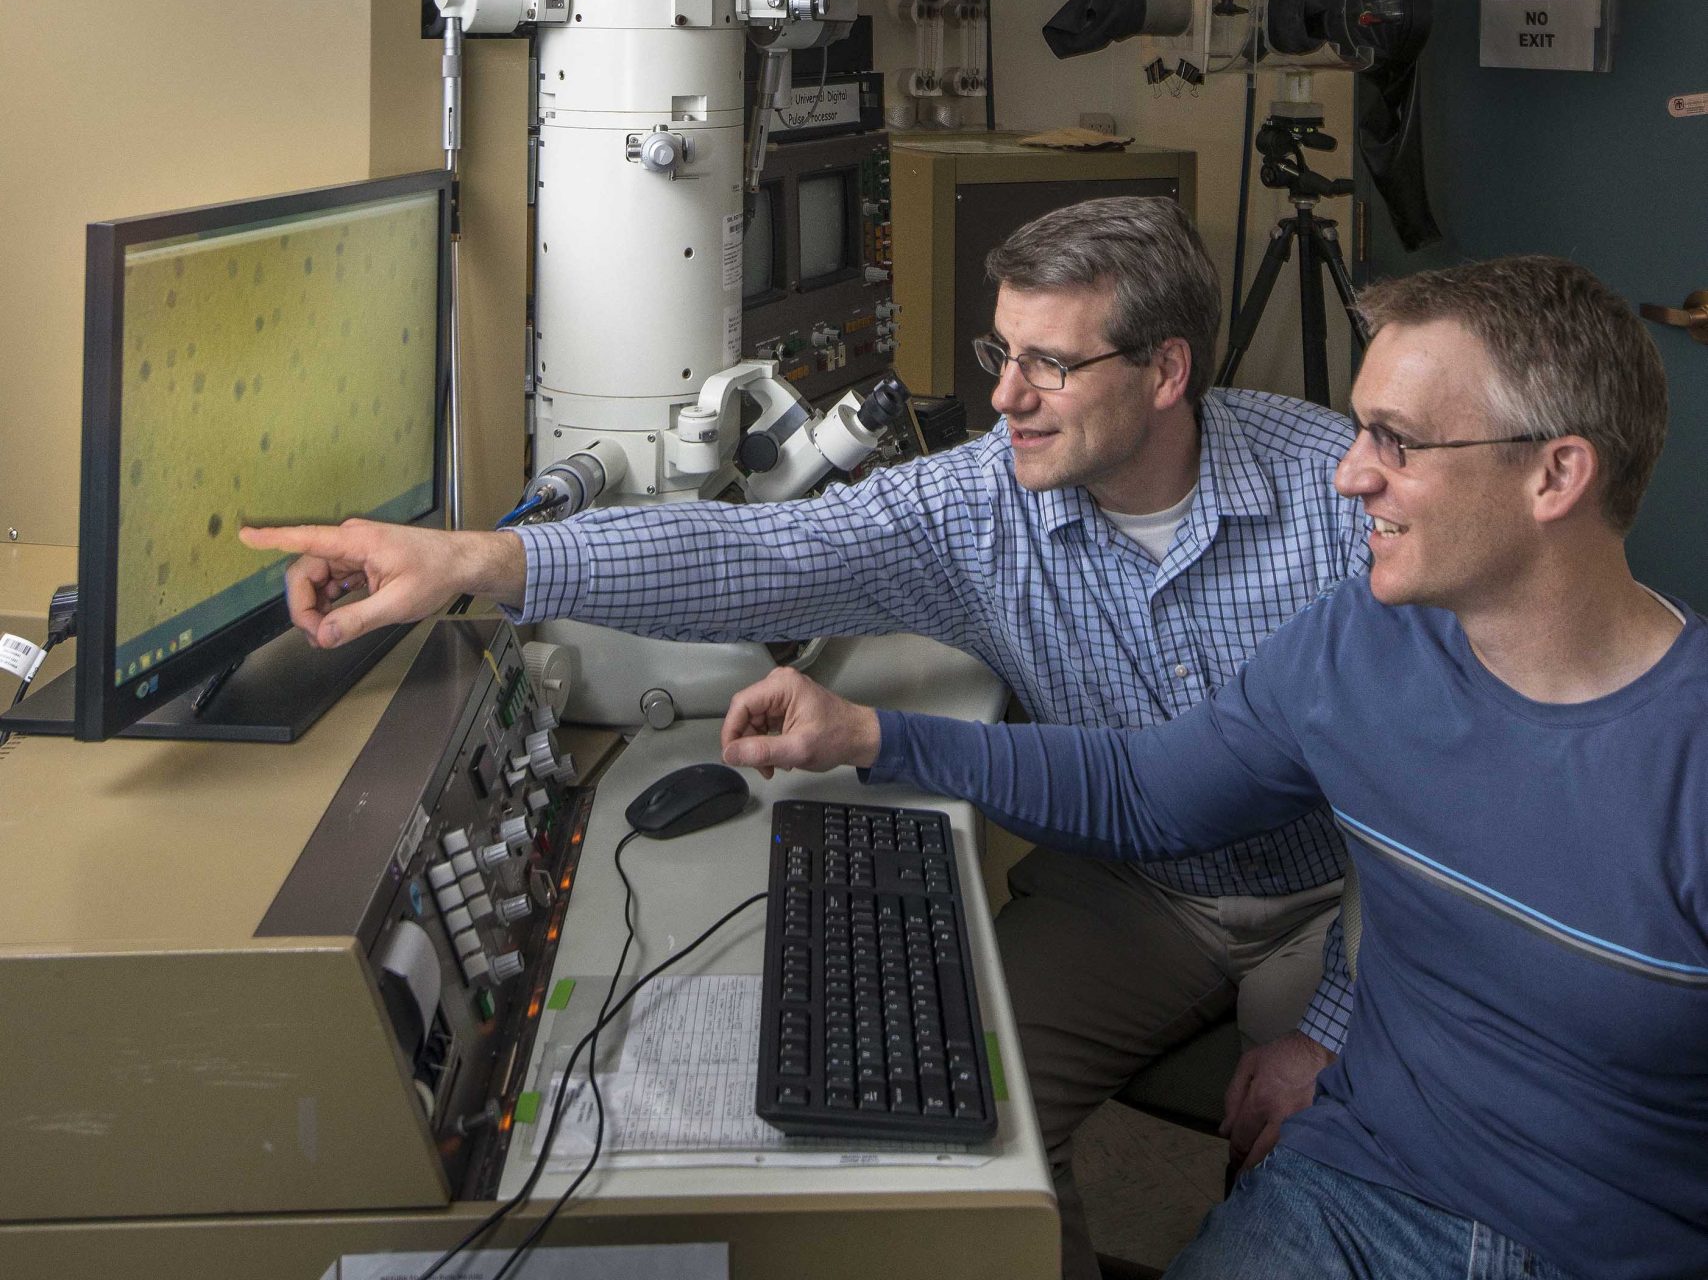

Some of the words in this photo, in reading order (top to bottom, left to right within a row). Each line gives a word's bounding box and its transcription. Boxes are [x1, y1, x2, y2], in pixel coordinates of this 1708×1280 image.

[1526, 11, 1548, 25] NO
[1519, 34, 1555, 47] EXIT
[795, 91, 824, 105] Univeral
[827, 89, 848, 104] Digital
[788, 113, 805, 125] Pulse
